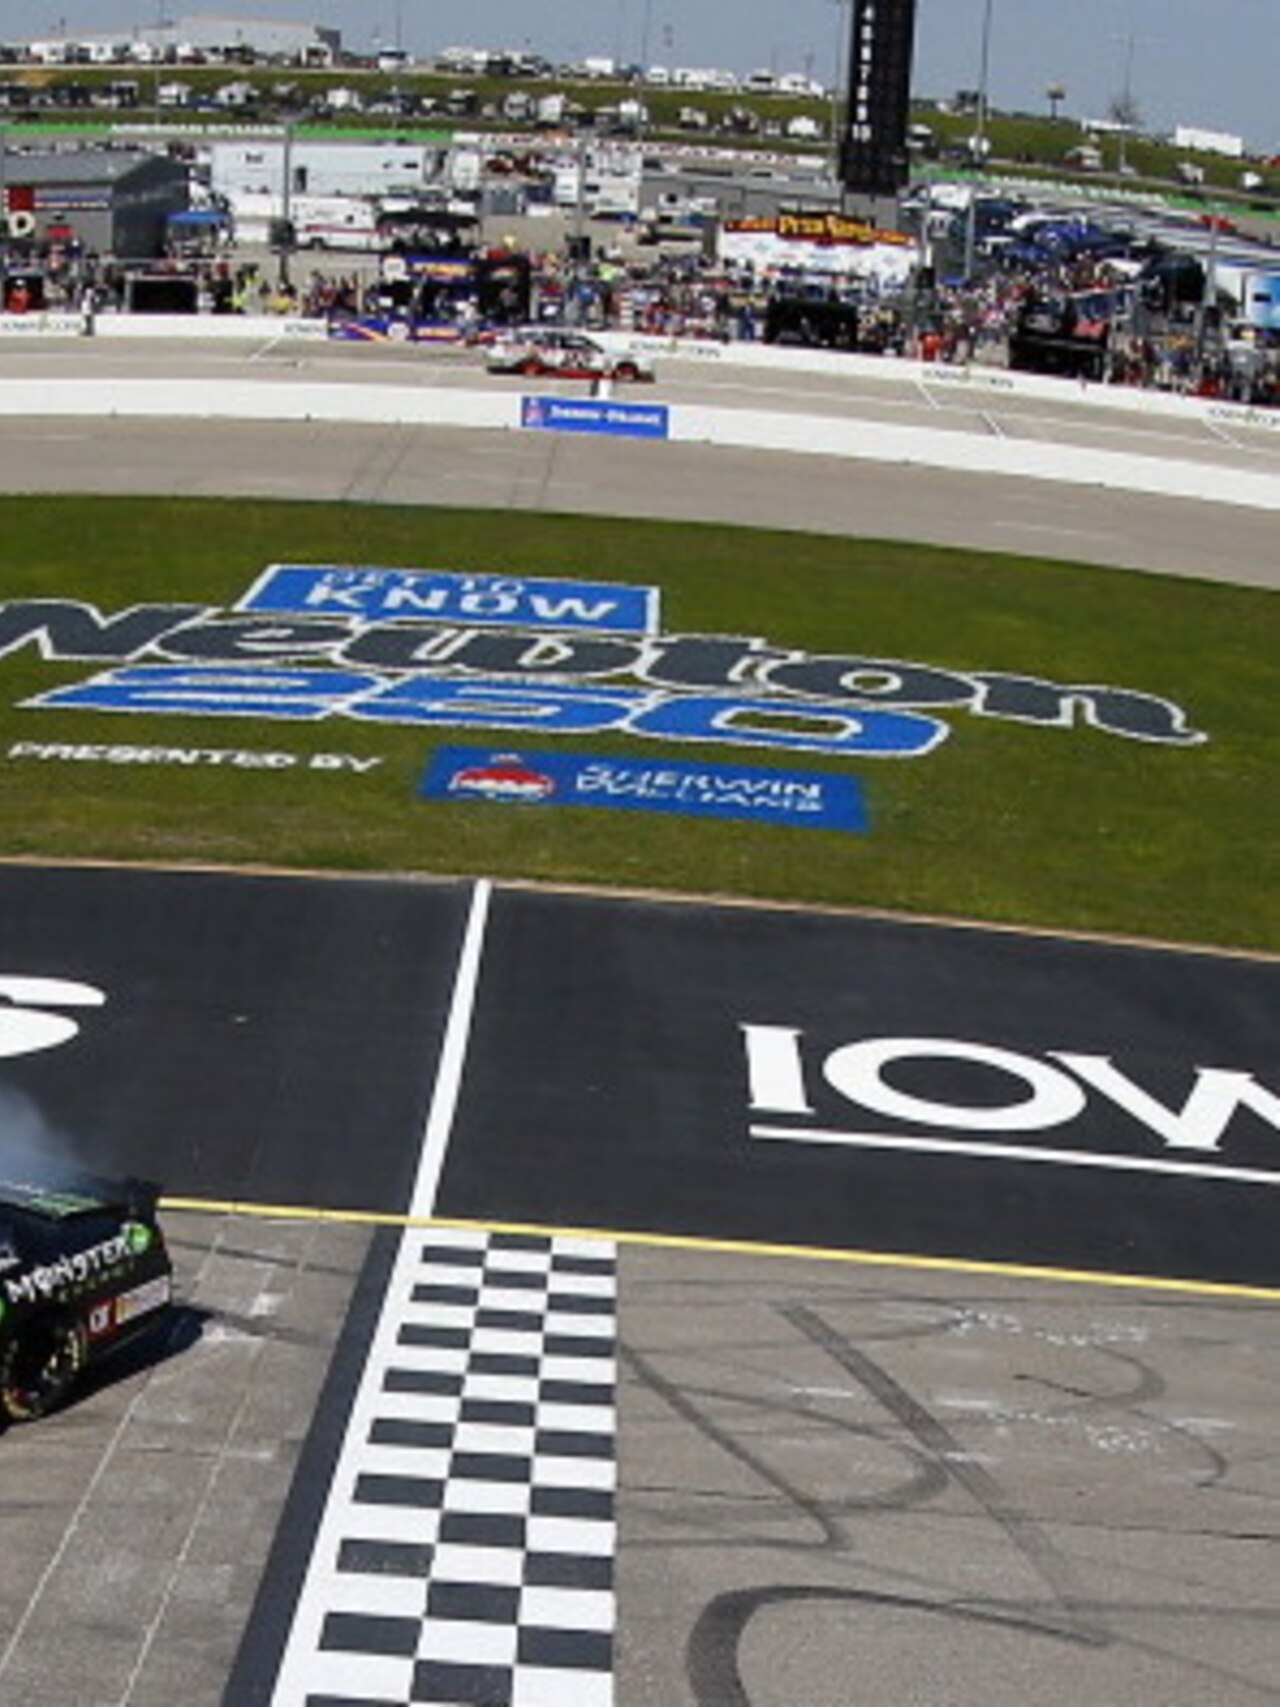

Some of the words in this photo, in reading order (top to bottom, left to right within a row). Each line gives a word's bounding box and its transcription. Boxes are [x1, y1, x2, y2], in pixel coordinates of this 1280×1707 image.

[304, 581, 618, 621] KNOW
[14, 661, 950, 758] 250
[7, 741, 298, 769] PRESENTED
[308, 753, 384, 773] BY
[4, 1222, 133, 1303] MONSTER
